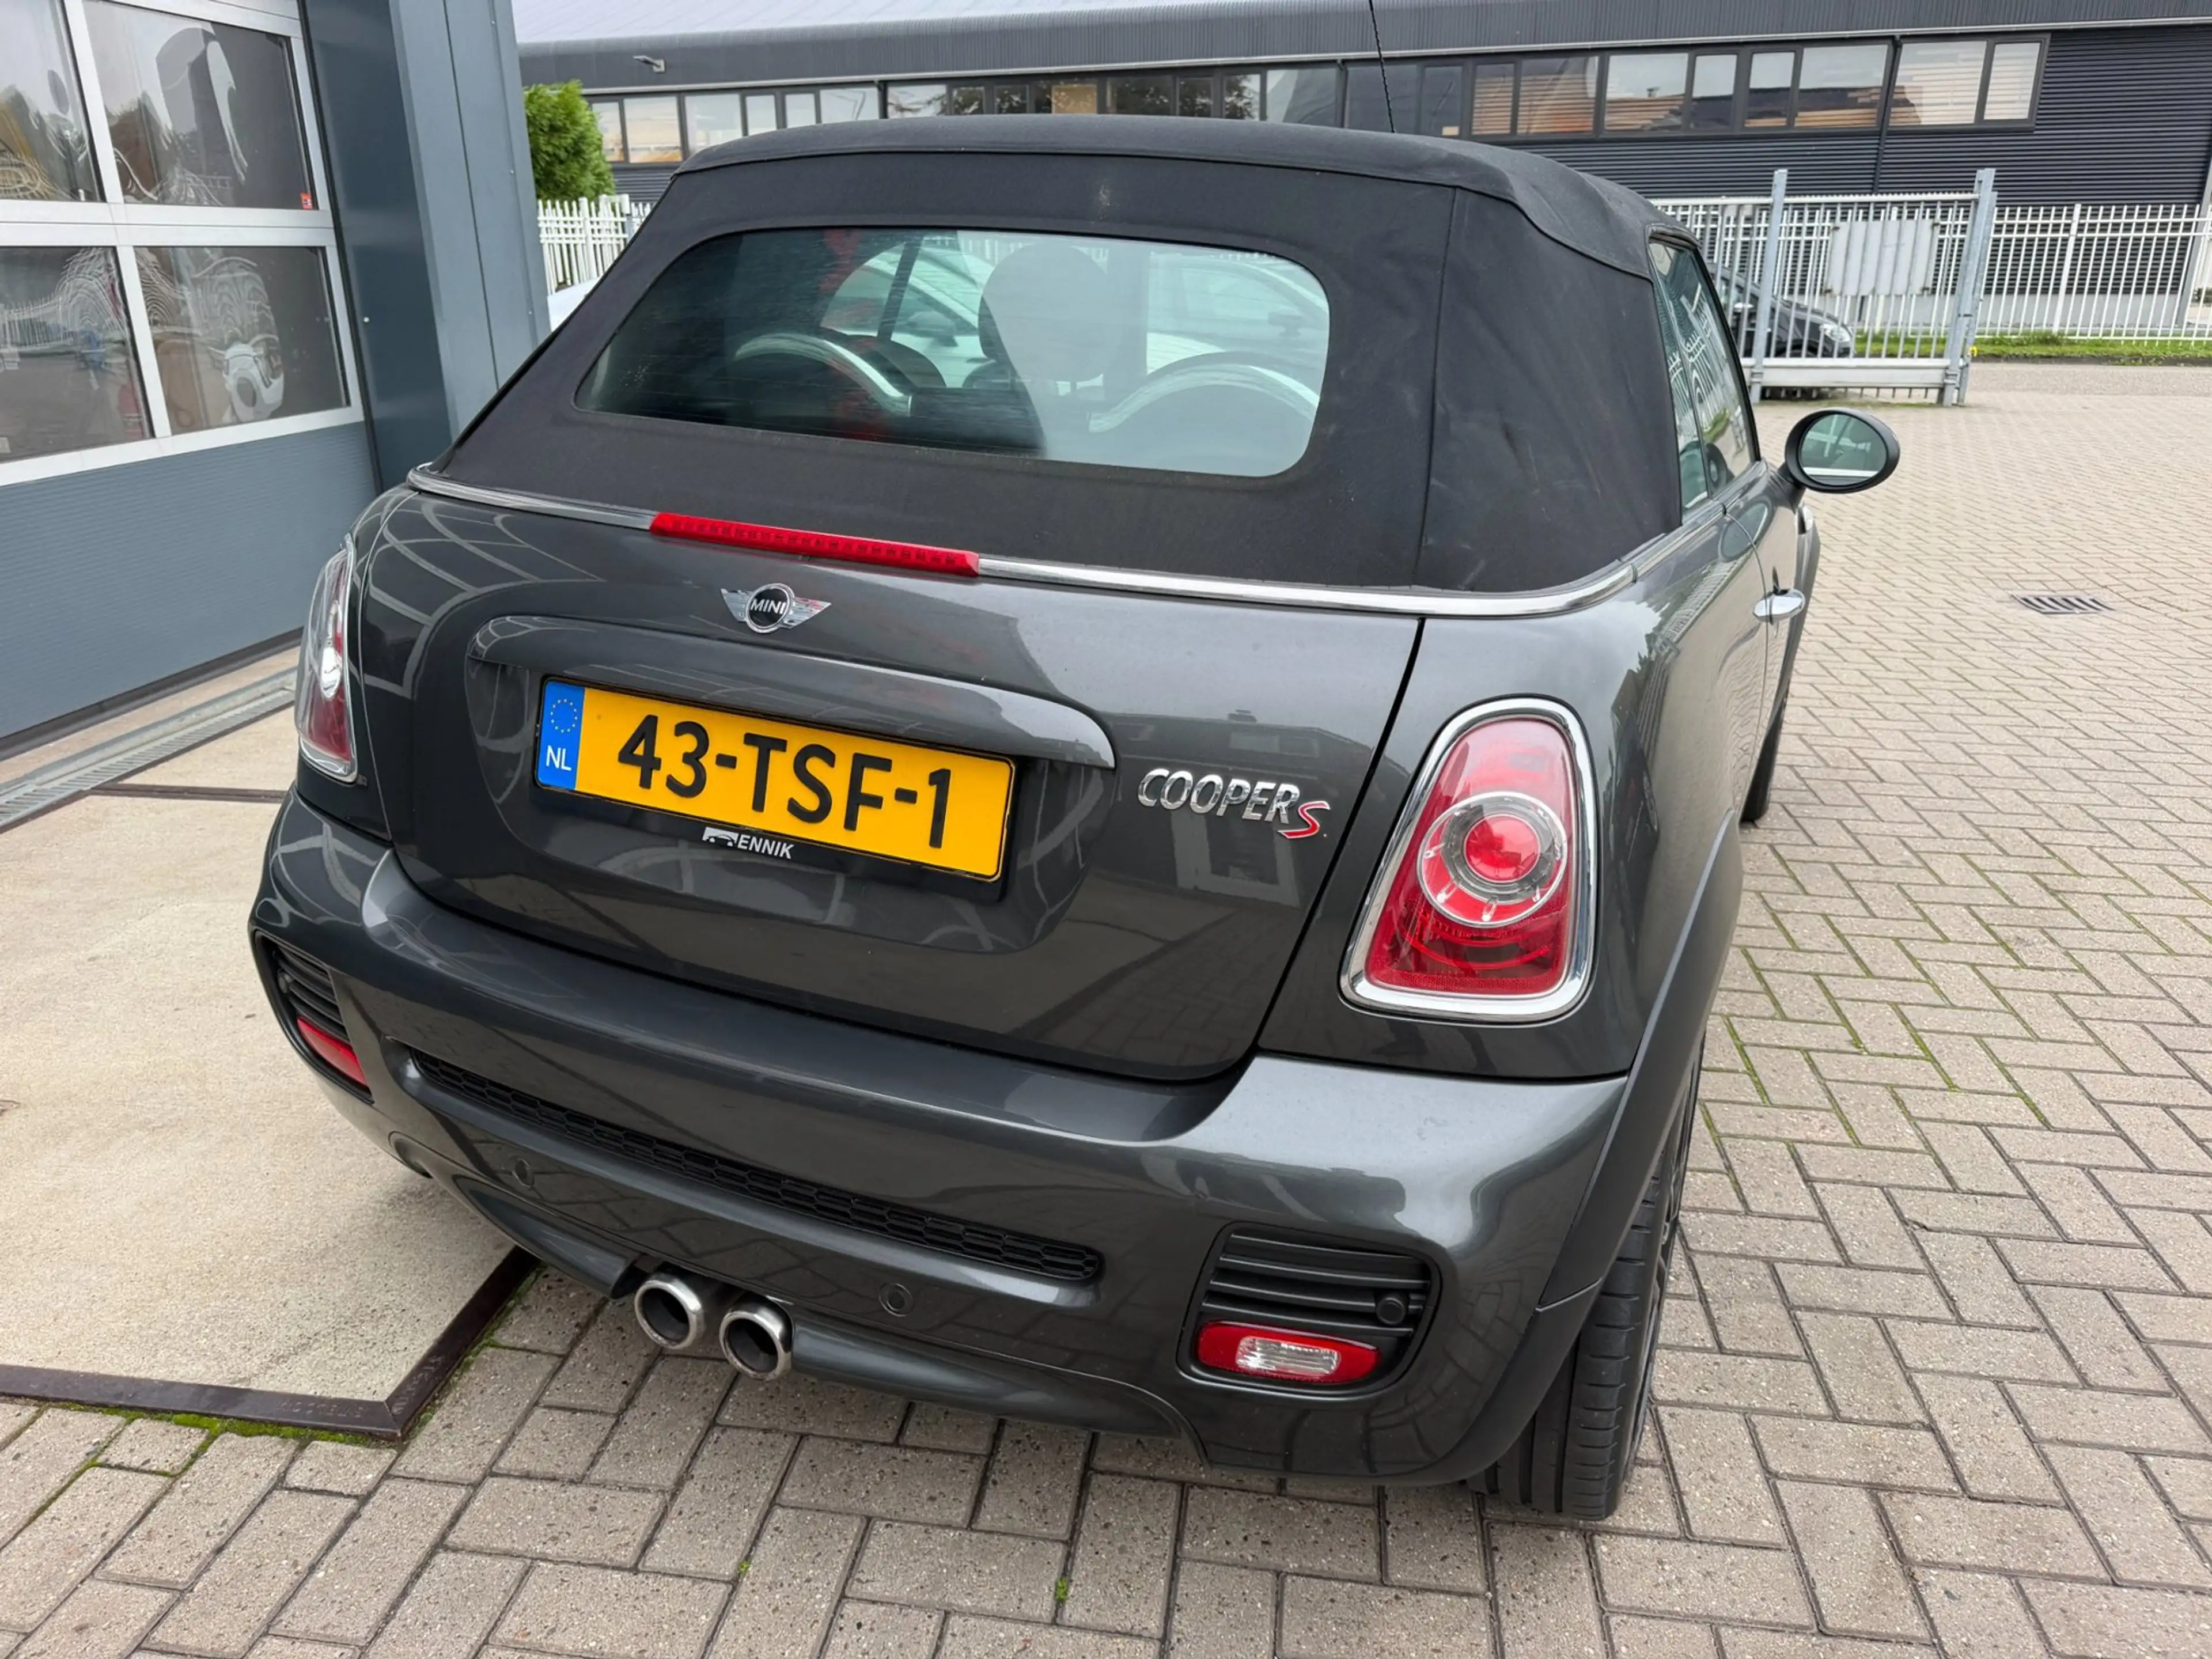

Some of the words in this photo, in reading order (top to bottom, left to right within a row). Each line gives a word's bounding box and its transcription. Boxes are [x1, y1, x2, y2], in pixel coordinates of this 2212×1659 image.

[750, 599, 787, 615] MINI
[546, 744, 572, 772] NL
[618, 714, 952, 849] 43-TSF-1
[1138, 768, 1301, 824] COOPER
[1278, 800, 1331, 839] S
